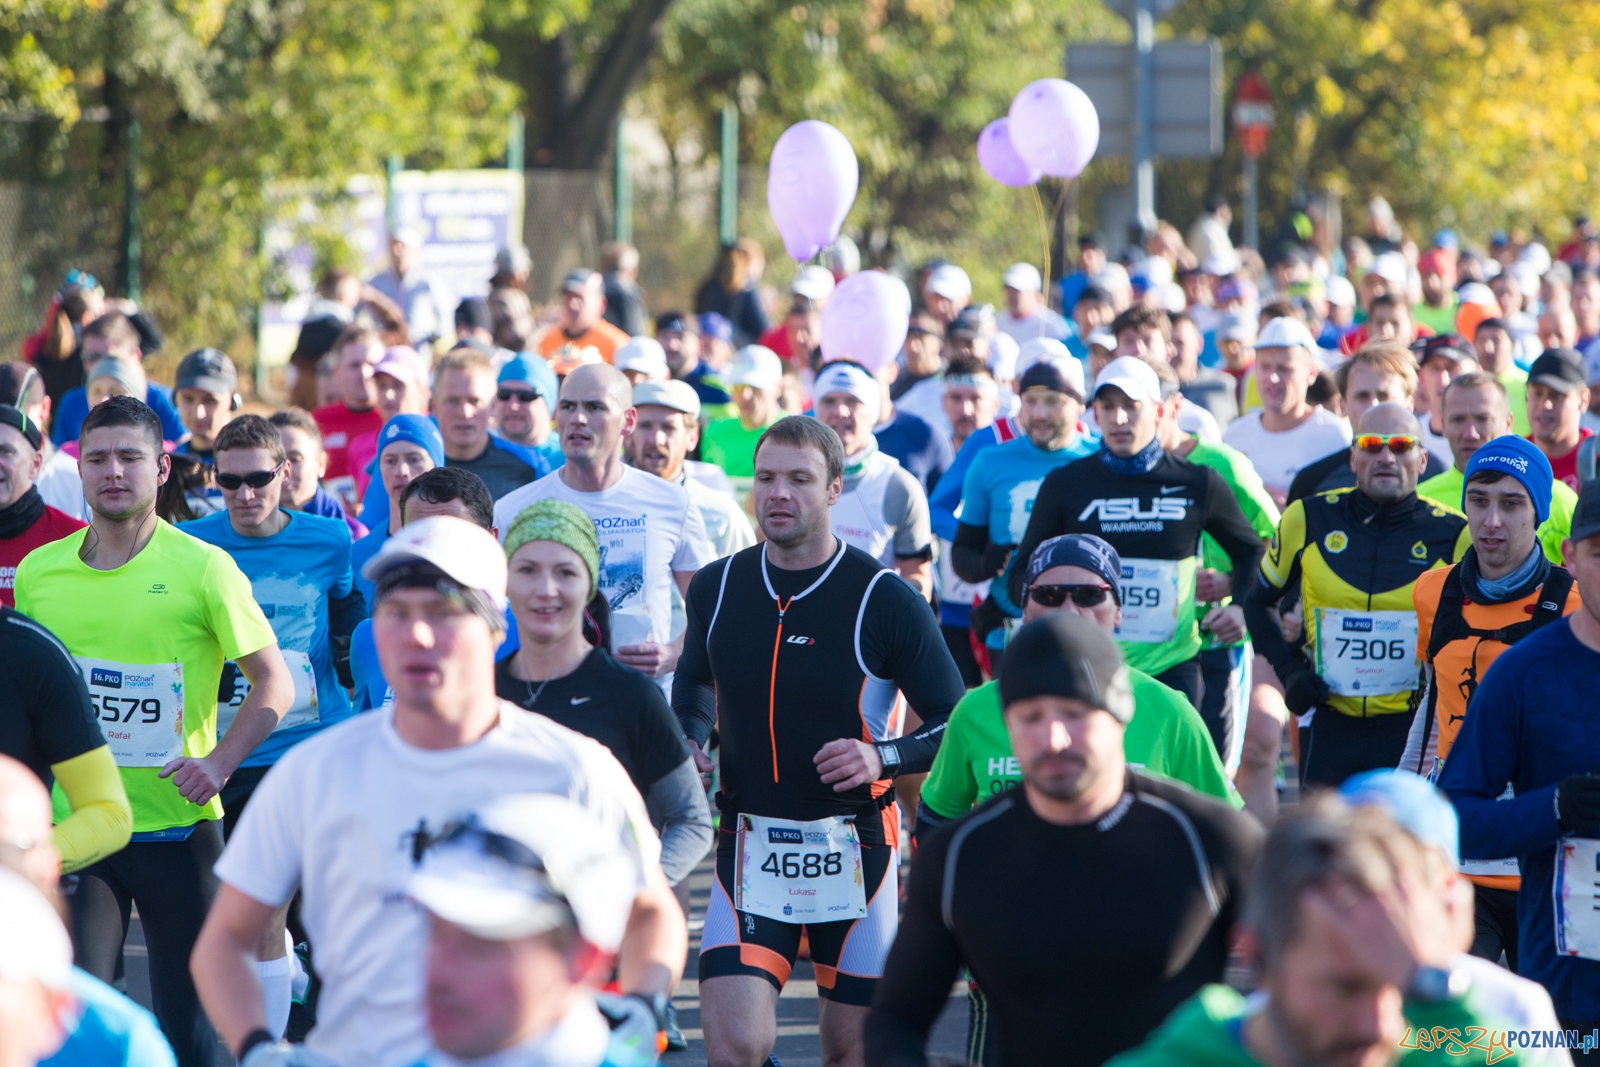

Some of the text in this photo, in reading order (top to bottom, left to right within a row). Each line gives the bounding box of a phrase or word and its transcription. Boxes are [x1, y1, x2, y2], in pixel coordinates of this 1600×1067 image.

[1478, 456, 1526, 474] marathon
[1078, 497, 1187, 521] ASUS
[1100, 521, 1164, 532] WARRIORS
[1120, 585, 1160, 608] 159
[1335, 637, 1405, 660] 7306
[1355, 667, 1385, 675] Szymon
[108, 731, 131, 740] Rafał
[760, 852, 842, 879] 4688
[788, 888, 817, 896] Łukasz
